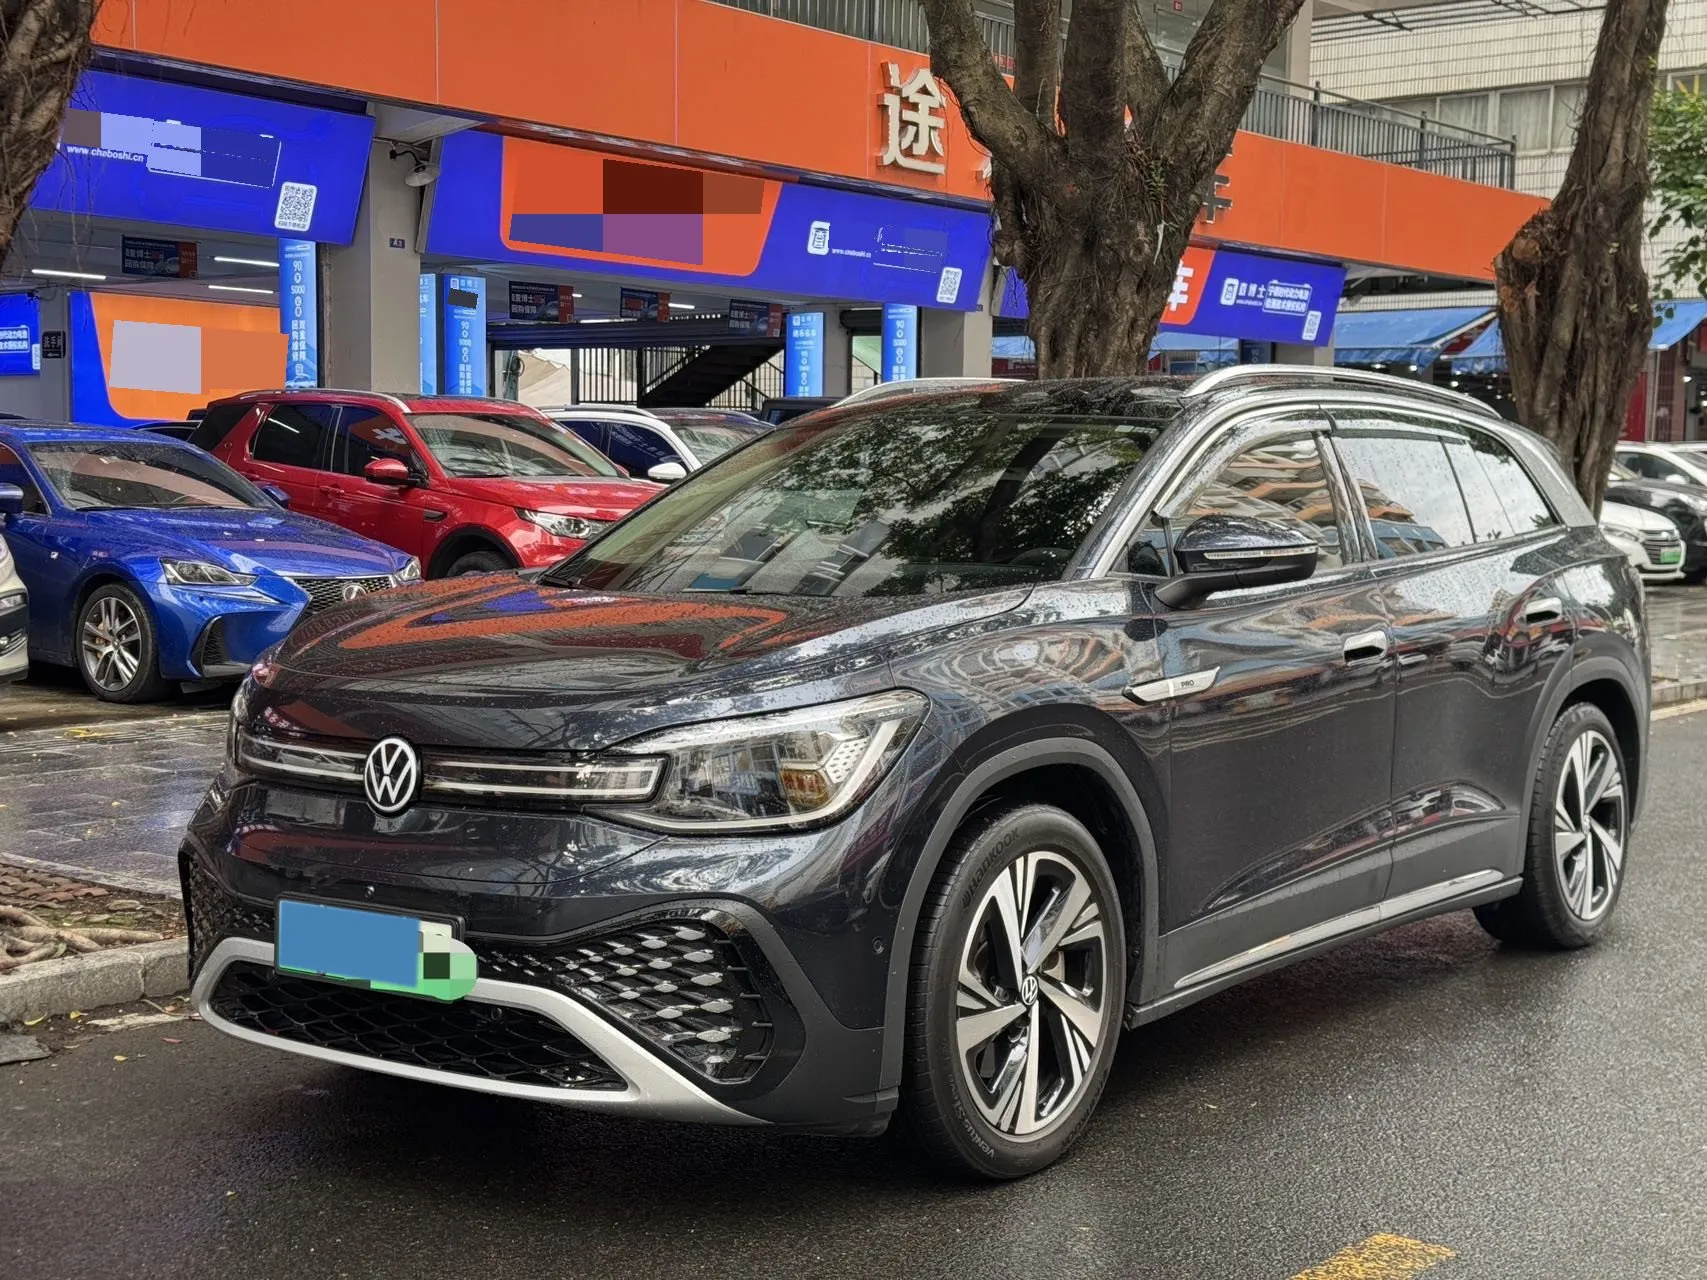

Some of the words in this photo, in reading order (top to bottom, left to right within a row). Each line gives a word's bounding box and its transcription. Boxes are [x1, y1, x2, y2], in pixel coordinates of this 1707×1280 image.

[879, 62, 945, 176] 途
[293, 260, 303, 272] 90
[1181, 679, 1195, 688] PRO
